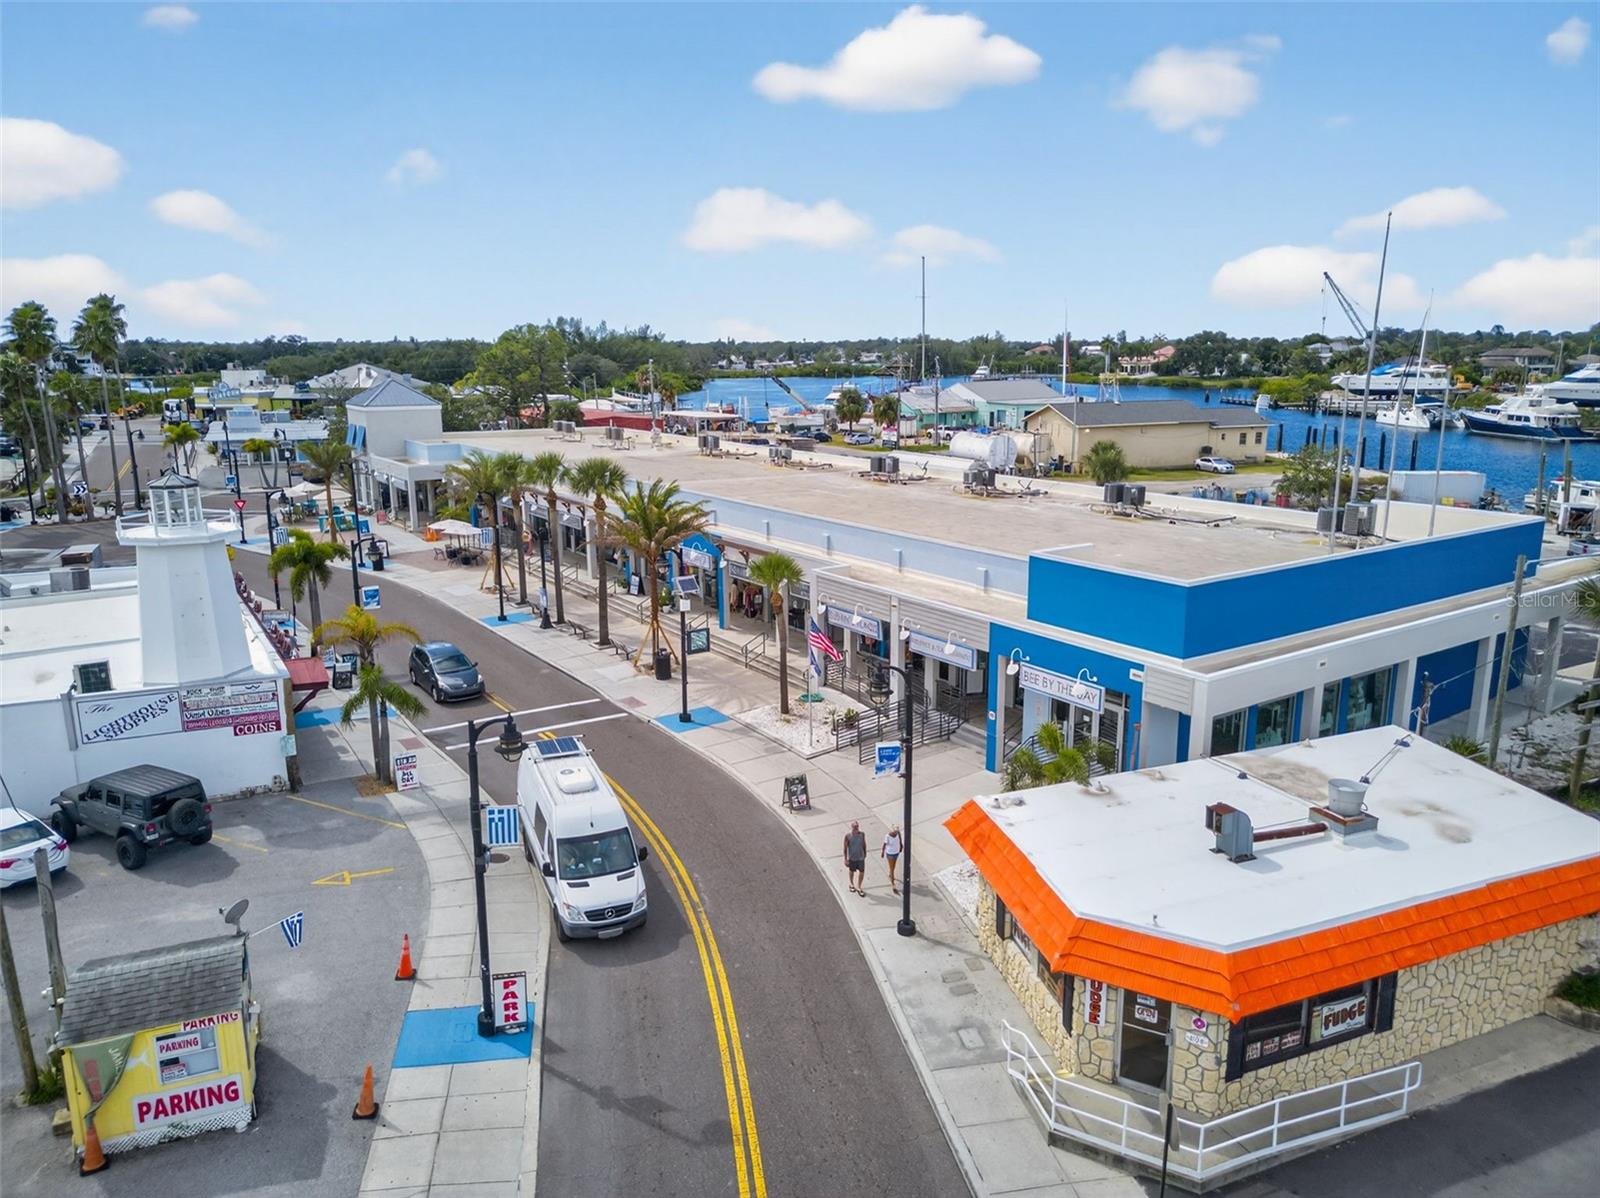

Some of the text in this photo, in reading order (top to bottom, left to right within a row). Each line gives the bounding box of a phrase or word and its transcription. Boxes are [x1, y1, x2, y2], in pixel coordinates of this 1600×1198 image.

[1023, 670, 1041, 685] BEE
[1041, 676, 1055, 691] BY
[1057, 680, 1075, 697] THE
[84, 693, 178, 741] LIGHTHOUSE
[103, 705, 168, 740] SHOPPES
[235, 721, 277, 736] COINS
[502, 979, 519, 1023] PARK
[1323, 1000, 1366, 1031] FUDGE
[183, 1013, 239, 1031] PARKING
[159, 1036, 199, 1053] PARKING
[137, 1080, 240, 1123] PARKING
